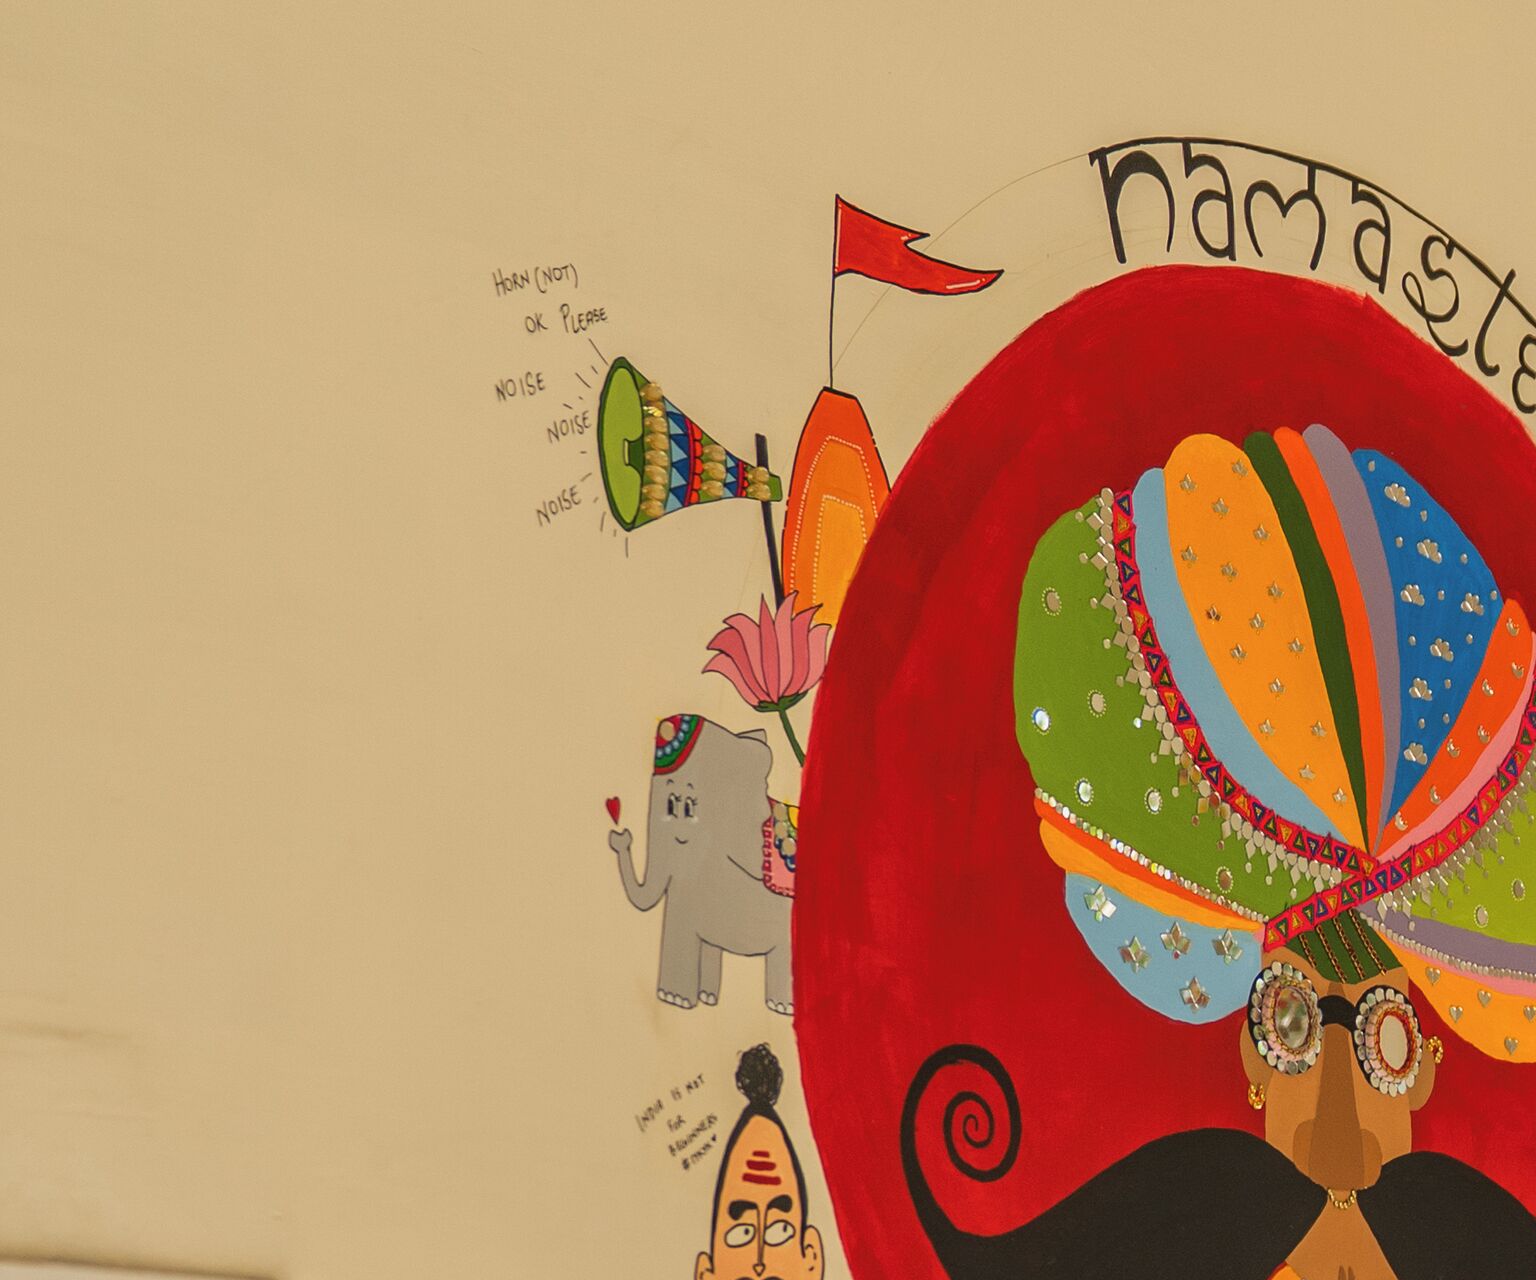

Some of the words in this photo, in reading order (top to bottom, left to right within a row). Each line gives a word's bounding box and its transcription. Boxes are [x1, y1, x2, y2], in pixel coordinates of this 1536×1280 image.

[492, 268, 530, 297] HORN
[534, 263, 579, 295] (NOT)
[525, 313, 549, 334] OK
[559, 303, 608, 334] PLEASE
[494, 371, 546, 402] NOISE
[546, 410, 592, 444] NOISE
[536, 484, 582, 527] NOISE
[685, 1073, 705, 1094] NOT
